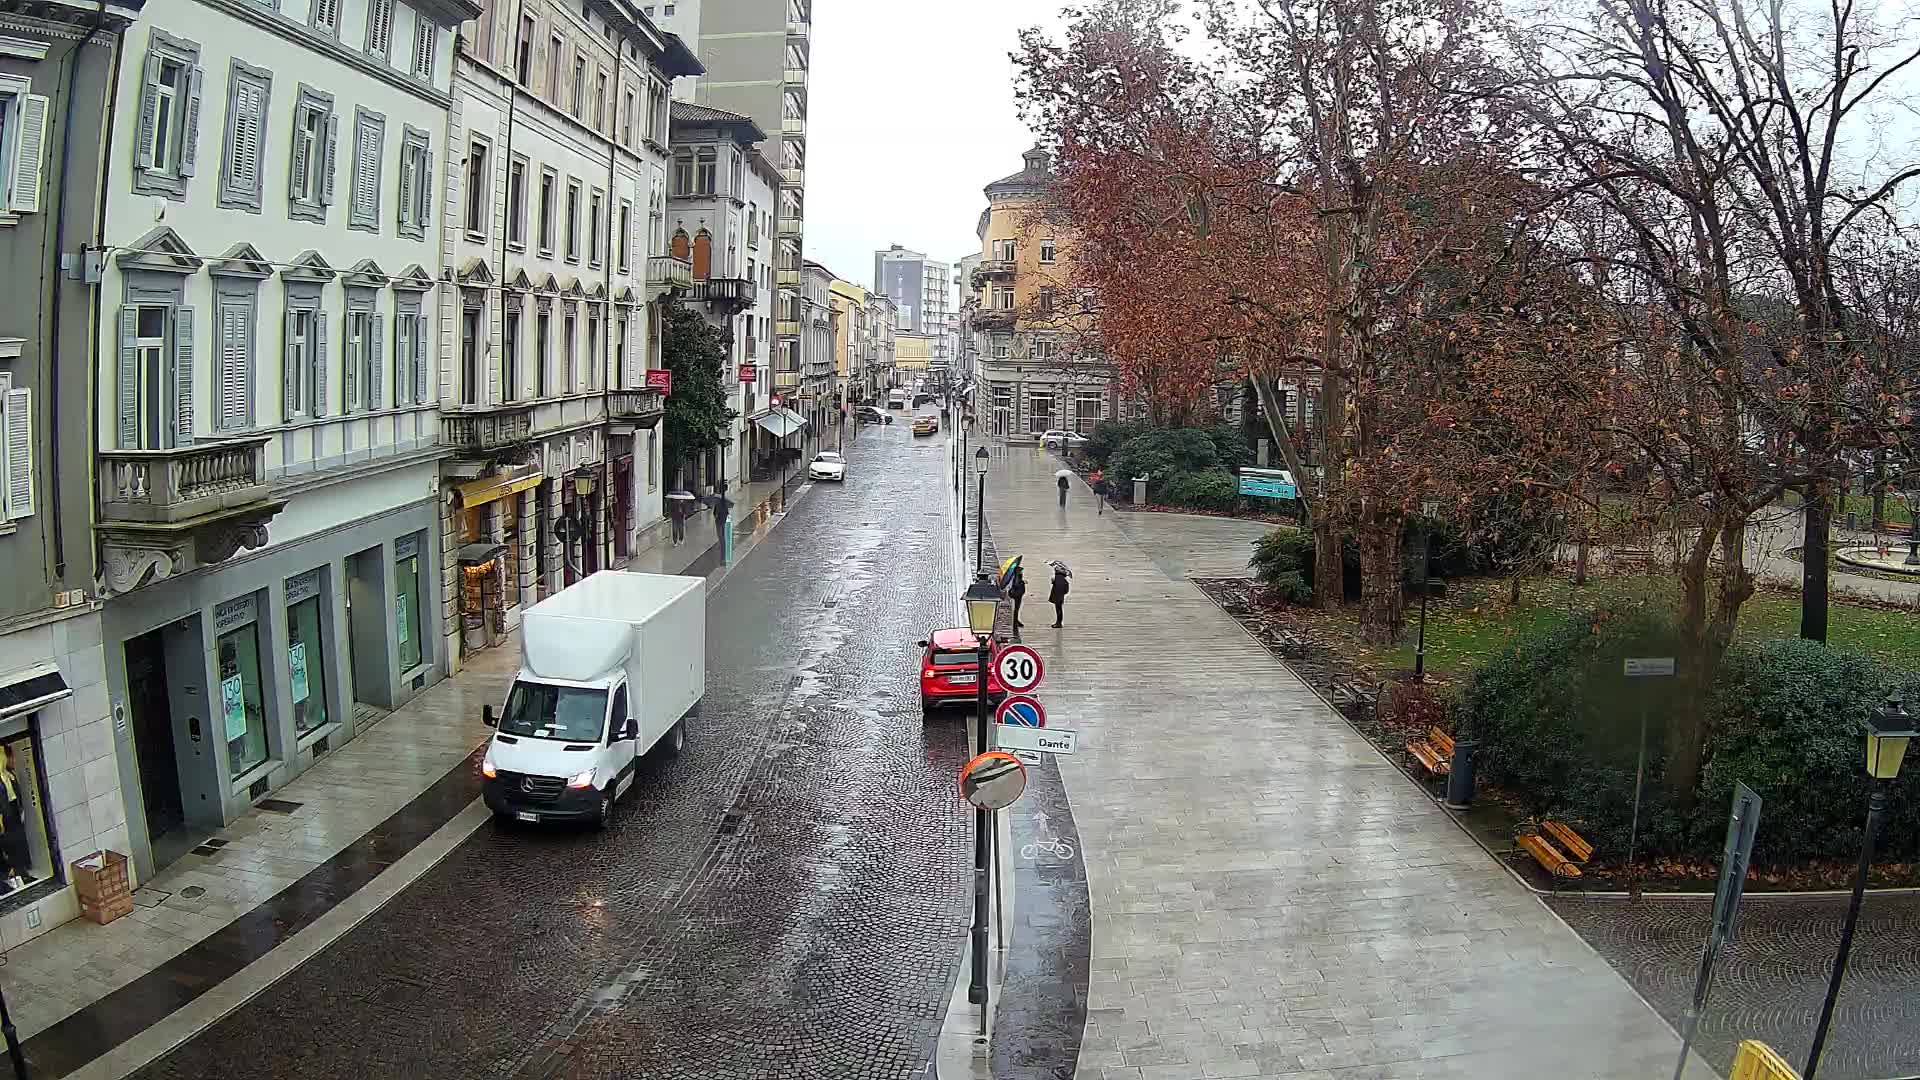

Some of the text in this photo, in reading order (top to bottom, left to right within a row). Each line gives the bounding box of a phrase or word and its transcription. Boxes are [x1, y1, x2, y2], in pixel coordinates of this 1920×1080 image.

[1006, 658, 1033, 680] 30
[223, 678, 241, 700] 130
[1039, 738, 1070, 749] Dante
